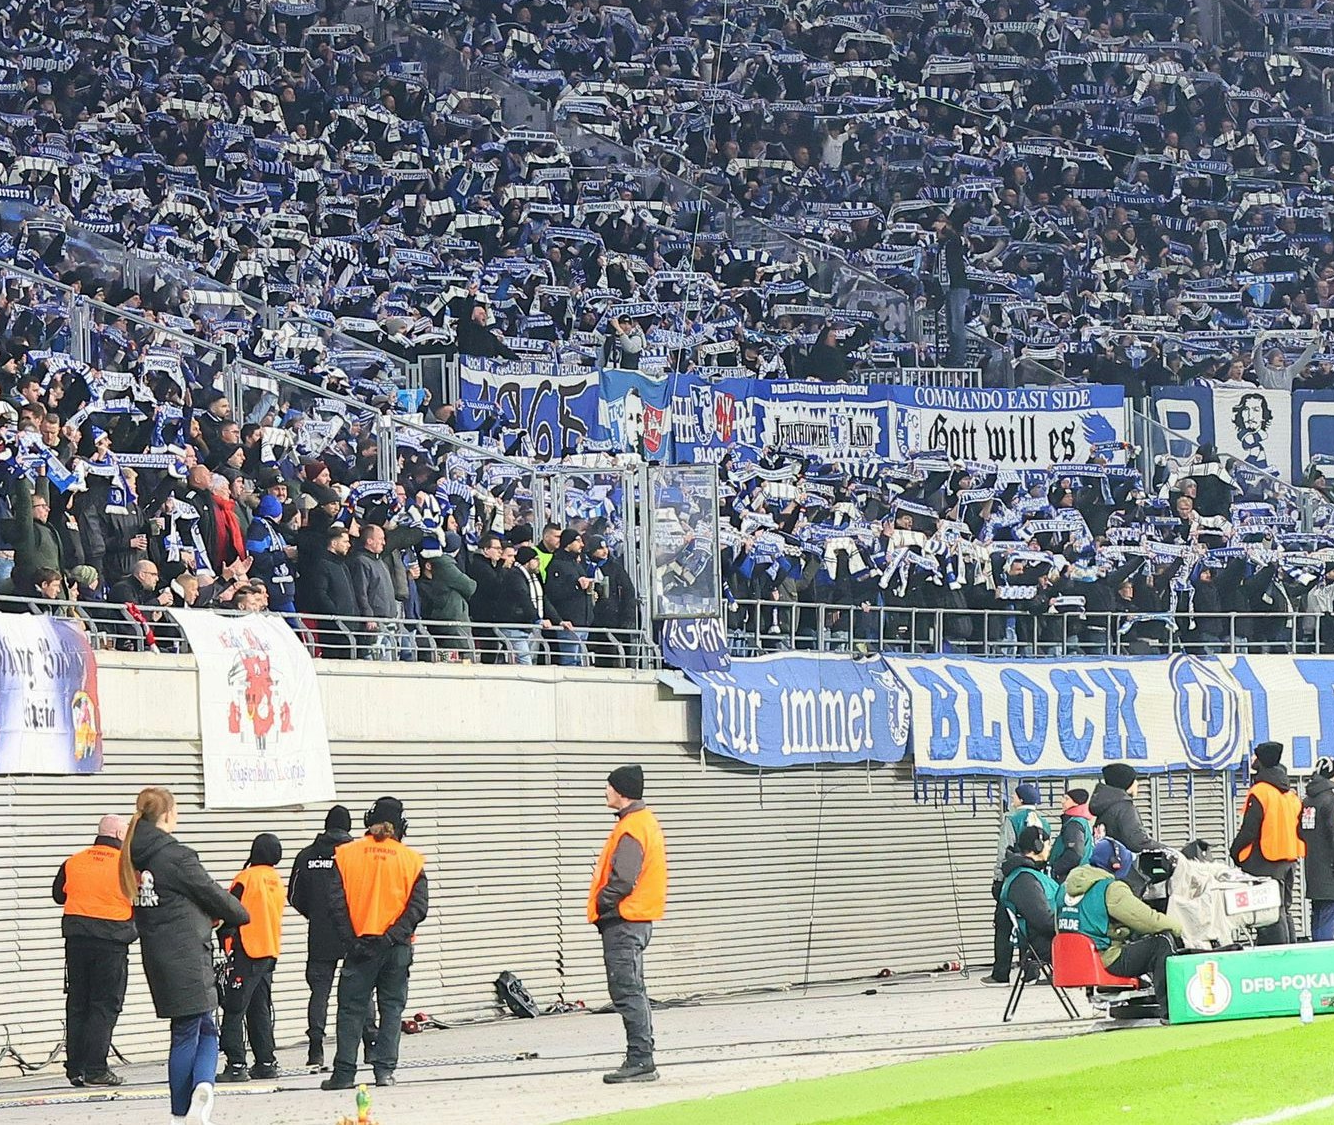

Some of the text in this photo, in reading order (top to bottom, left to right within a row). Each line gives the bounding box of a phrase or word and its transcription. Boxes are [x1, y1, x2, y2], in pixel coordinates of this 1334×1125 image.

[534, 362, 555, 375] NICHT
[771, 384, 868, 397] DER REGION VERBUNDEN
[915, 387, 1091, 410] COMMANDO EAST SIDE
[772, 415, 830, 450] JERICHOWER
[849, 419, 873, 447] LAND
[928, 413, 1077, 464] Gott will es
[117, 453, 176, 468] MAGDEBURG
[766, 672, 876, 755] immer
[907, 663, 1148, 765] BLOCK
